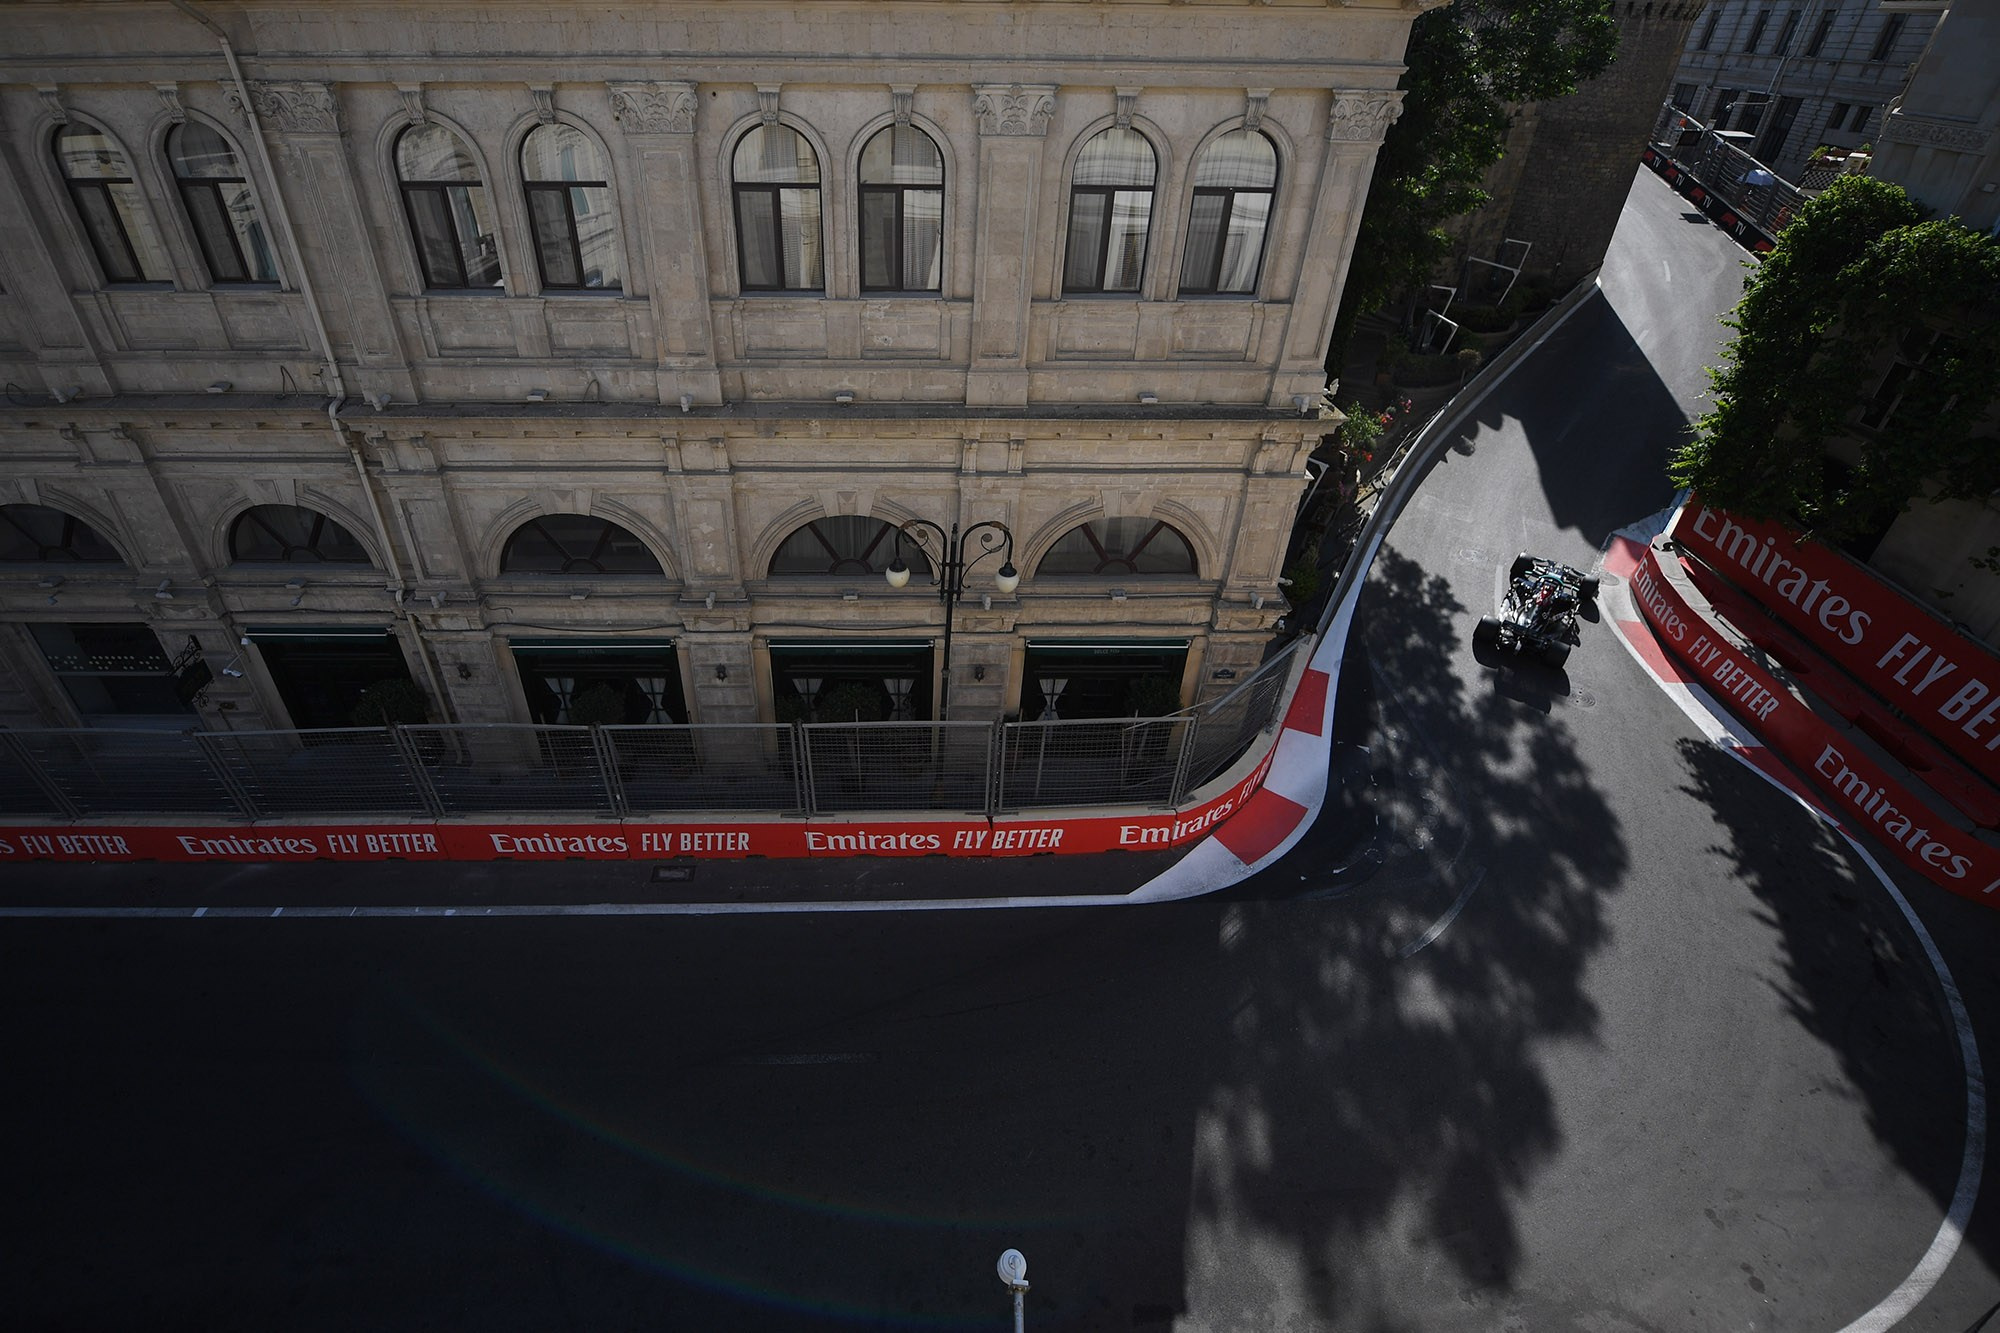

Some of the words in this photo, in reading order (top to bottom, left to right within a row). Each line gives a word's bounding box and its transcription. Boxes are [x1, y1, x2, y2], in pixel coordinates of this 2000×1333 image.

[1653, 156, 1662, 168] TV
[1675, 174, 1685, 186] TV
[1702, 195, 1713, 209] TV
[1735, 221, 1747, 236] TV
[1692, 504, 1872, 645] Emirates
[1876, 632, 1959, 696] FLY
[1634, 557, 1688, 641] Emirates
[1688, 635, 1722, 668] FLY
[1713, 658, 1780, 722] BETTER
[1120, 798, 1234, 845] Emirates
[1814, 743, 1973, 879] Emirates
[20, 835, 55, 854] FLY
[57, 835, 132, 854] BETTER
[177, 835, 318, 855] Emirates
[327, 834, 361, 854] FLY
[365, 833, 439, 853] BETTER
[489, 832, 628, 853] Emirates
[641, 832, 673, 852] FLY
[681, 832, 750, 851] BETTER
[806, 830, 942, 850] Emirates
[953, 830, 989, 849] FLY
[992, 829, 1064, 849] BETTER
